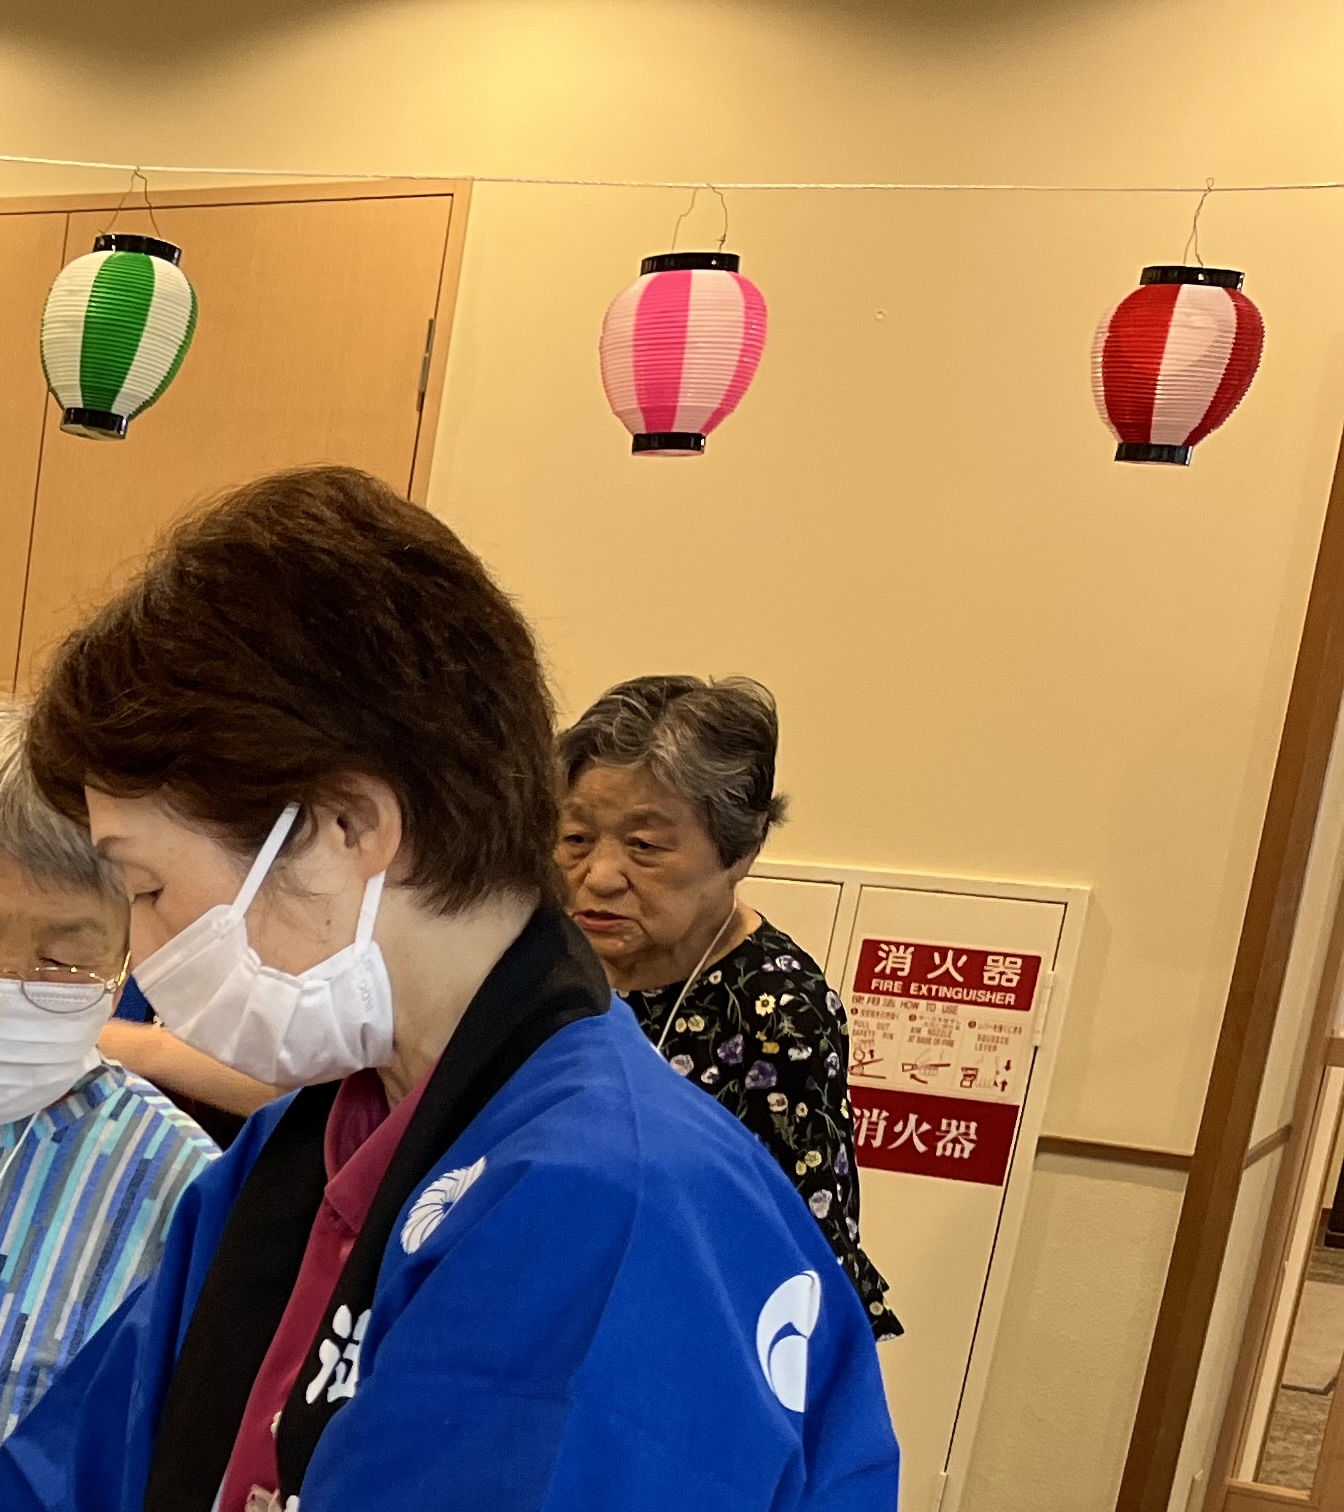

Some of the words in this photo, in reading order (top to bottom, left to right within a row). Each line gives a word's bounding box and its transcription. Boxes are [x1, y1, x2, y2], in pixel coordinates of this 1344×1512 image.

[874, 943, 1023, 988] 消火器
[870, 978, 903, 994] FIRE
[909, 982, 1016, 1006] EXTINGUISHER
[900, 1001, 920, 1011] HOW
[925, 1002, 937, 1012] TO
[852, 1107, 979, 1160] 消火器
